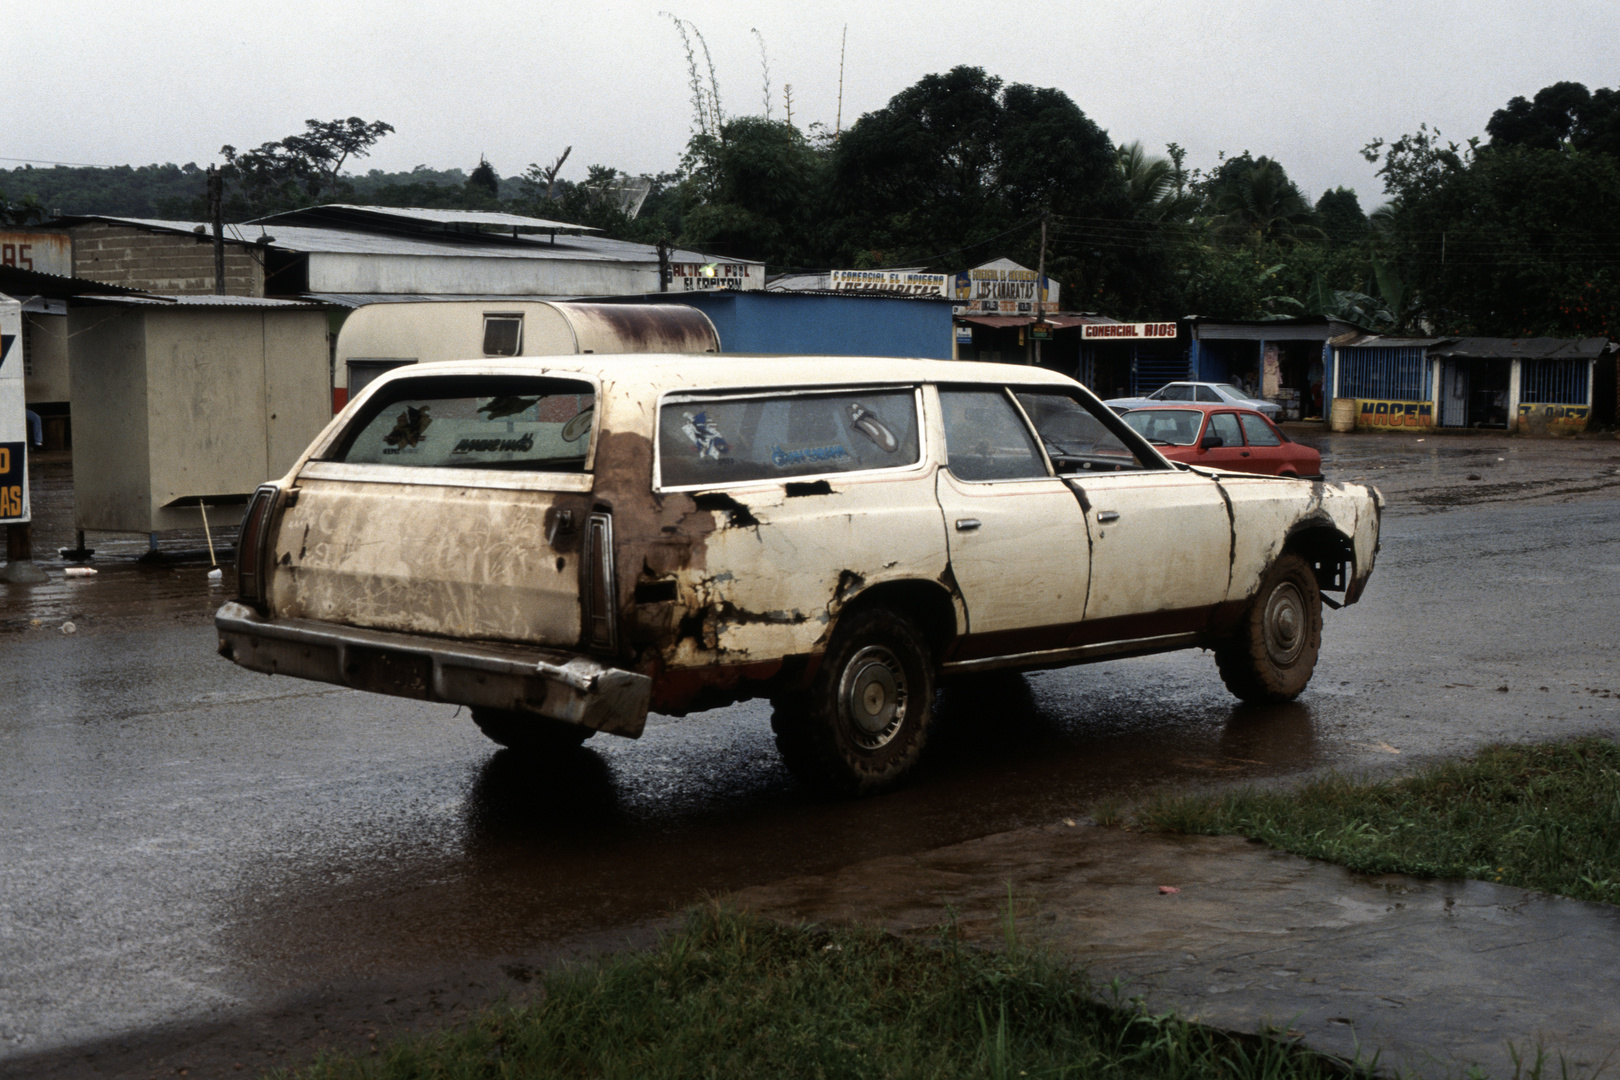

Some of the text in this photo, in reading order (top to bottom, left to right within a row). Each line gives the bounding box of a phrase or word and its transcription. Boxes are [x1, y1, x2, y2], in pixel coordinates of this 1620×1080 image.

[725, 265, 750, 277] POOL
[841, 271, 886, 283] COMERCIAL
[889, 273, 900, 284] EL
[977, 282, 991, 299] LOS
[1085, 324, 1176, 337] COMERCIAL RIOS
[1355, 403, 1432, 427] MACEN
